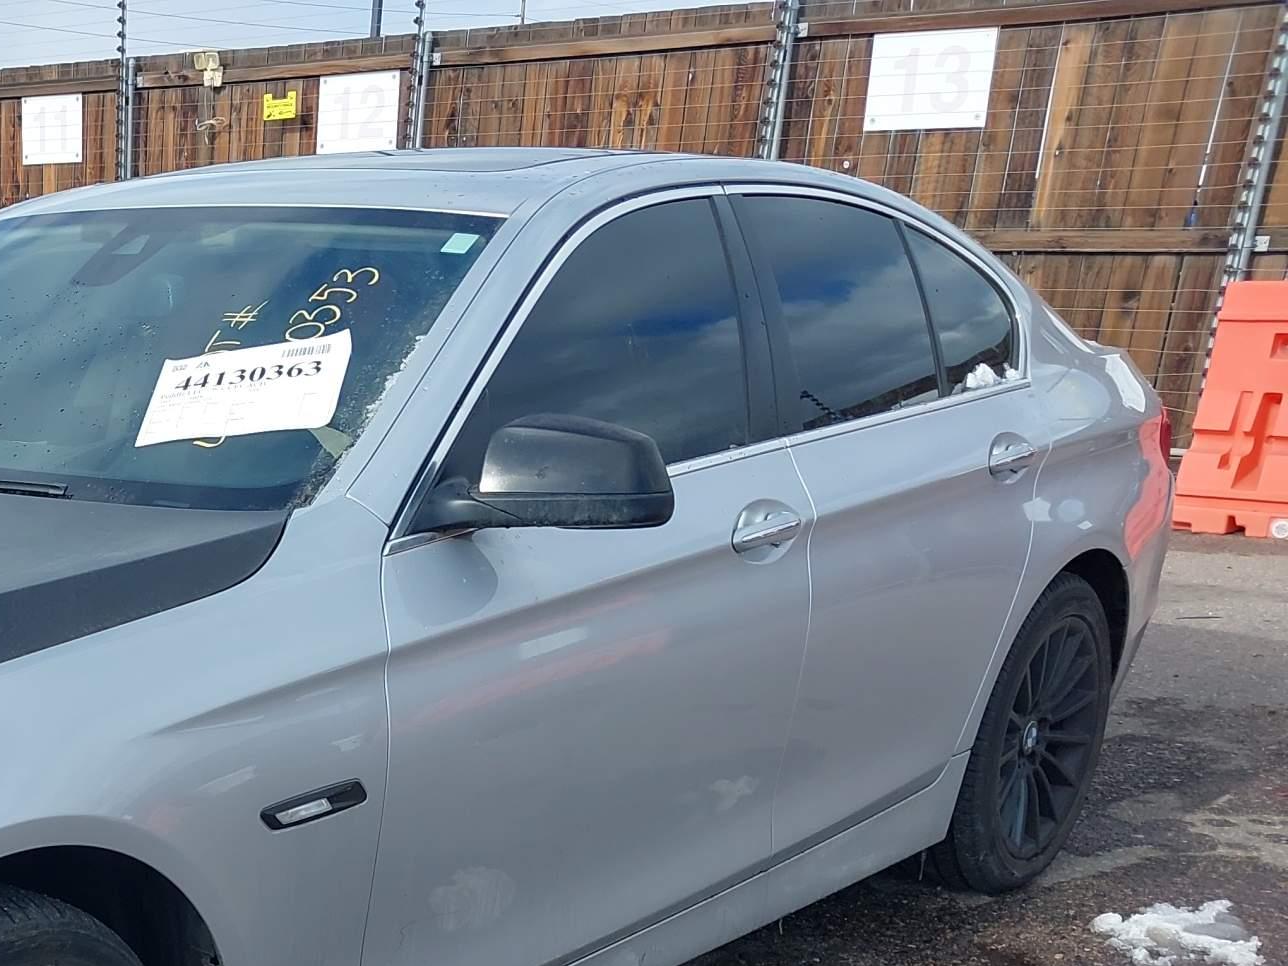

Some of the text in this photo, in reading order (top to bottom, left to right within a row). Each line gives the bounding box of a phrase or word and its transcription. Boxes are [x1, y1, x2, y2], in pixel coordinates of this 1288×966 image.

[893, 45, 971, 113] 13
[33, 105, 67, 153] 11
[334, 84, 385, 140] 12
[174, 360, 323, 391] 44130363
